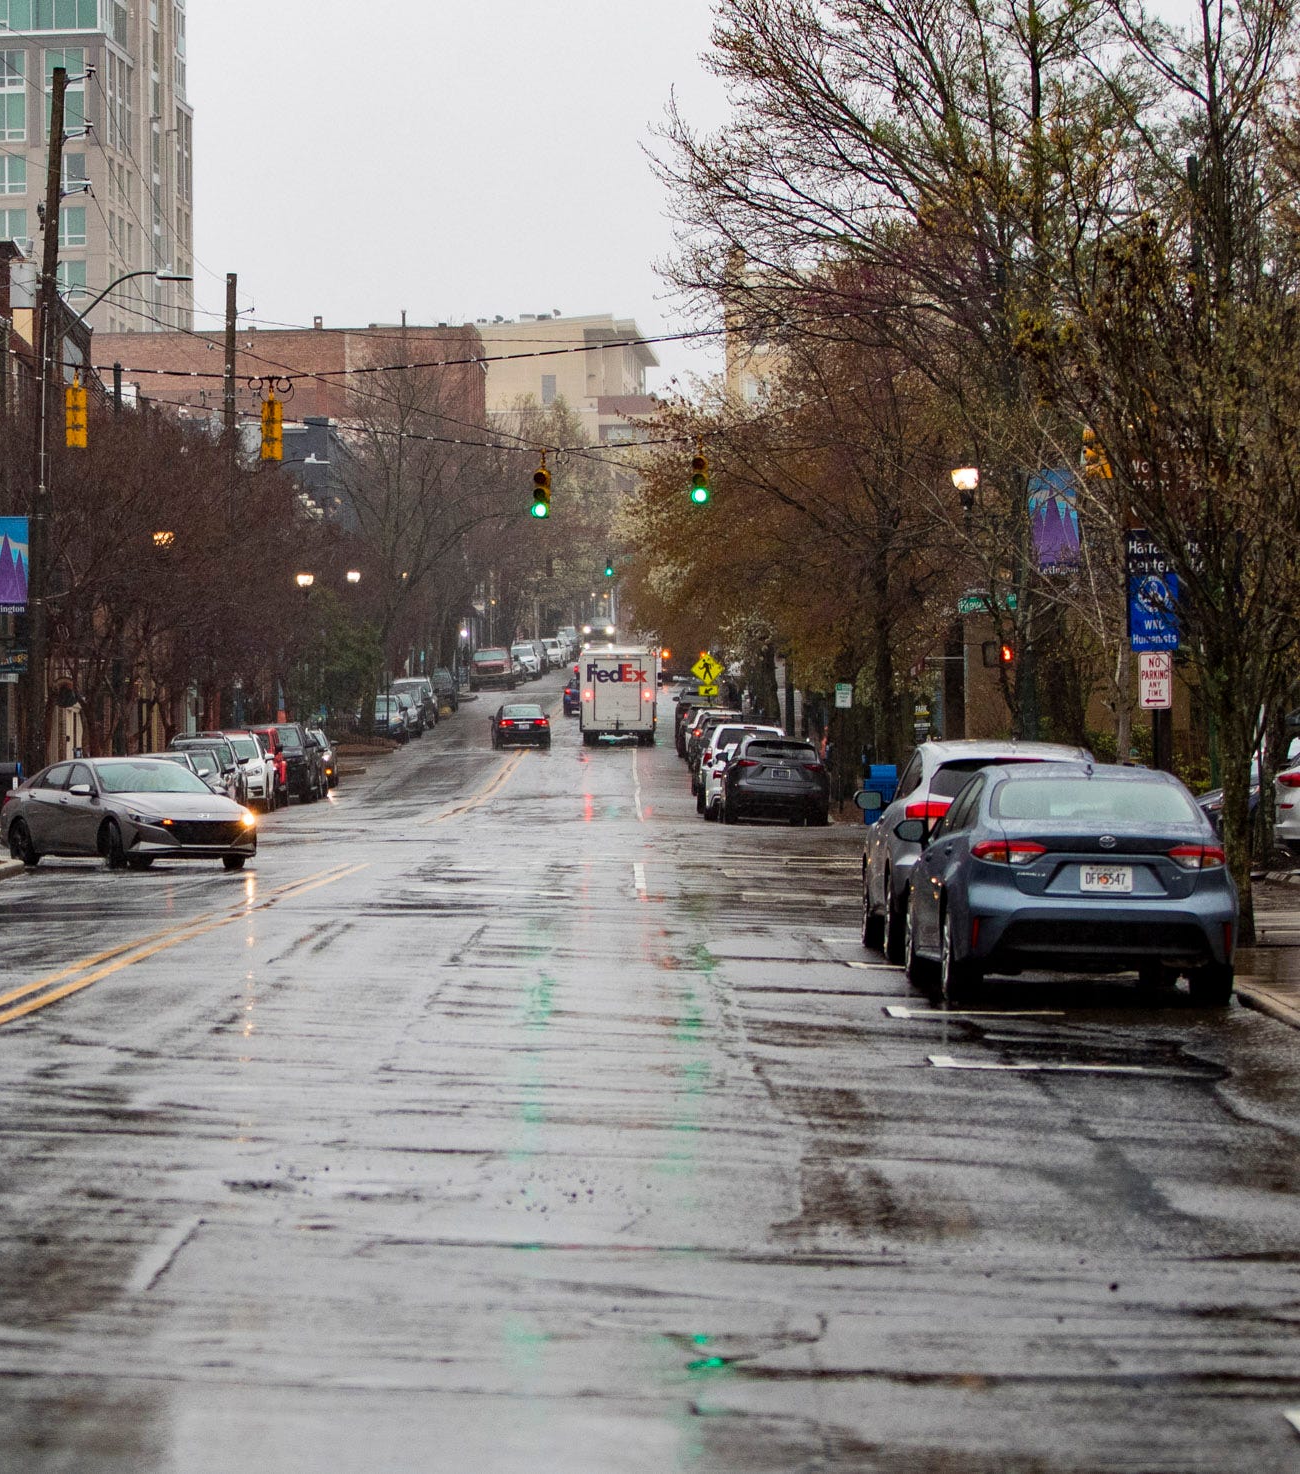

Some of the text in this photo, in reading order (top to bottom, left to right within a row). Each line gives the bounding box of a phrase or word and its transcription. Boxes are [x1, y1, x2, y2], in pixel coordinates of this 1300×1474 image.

[1144, 619, 1165, 631] WNC
[1148, 657, 1161, 668] NO
[586, 663, 648, 683] FedEx
[1141, 669, 1169, 681] PARKING
[1148, 681, 1161, 689] ANY
[1148, 689, 1163, 697] TIME
